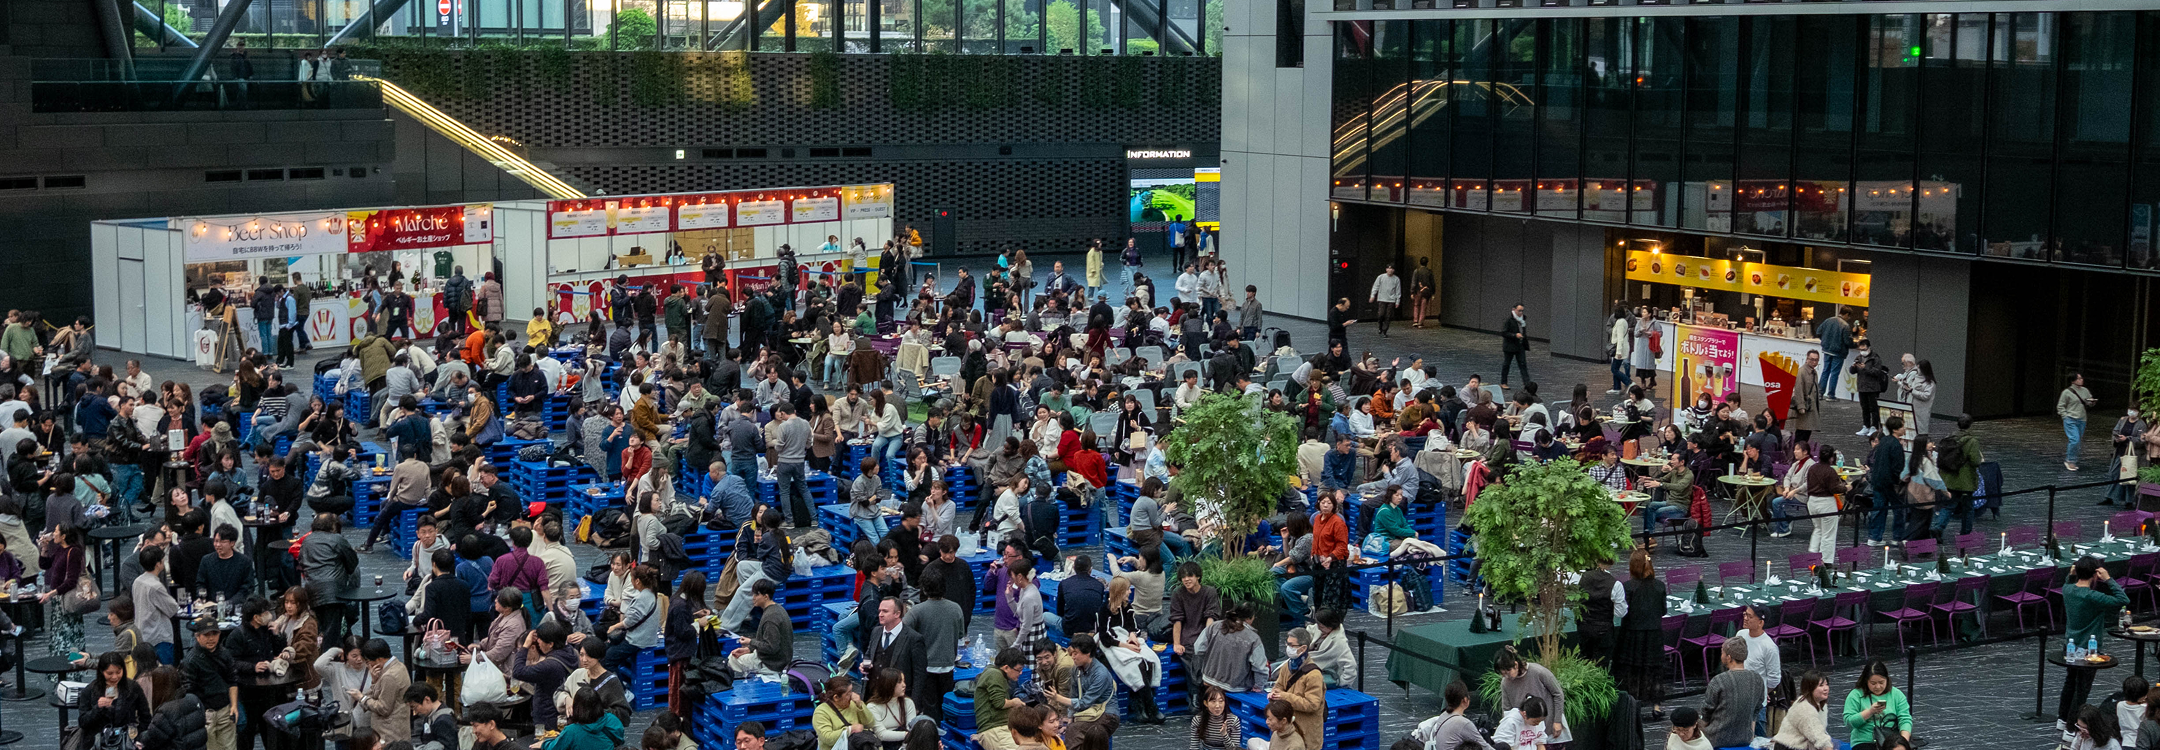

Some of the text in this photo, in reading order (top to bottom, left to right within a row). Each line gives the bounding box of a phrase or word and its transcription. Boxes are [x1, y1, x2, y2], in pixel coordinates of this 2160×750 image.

[1127, 150, 1191, 159] INFORMATION
[395, 212, 449, 233] Marché
[228, 222, 308, 242] Beer Shop
[395, 234, 451, 244] ベルギーお土産ショップ
